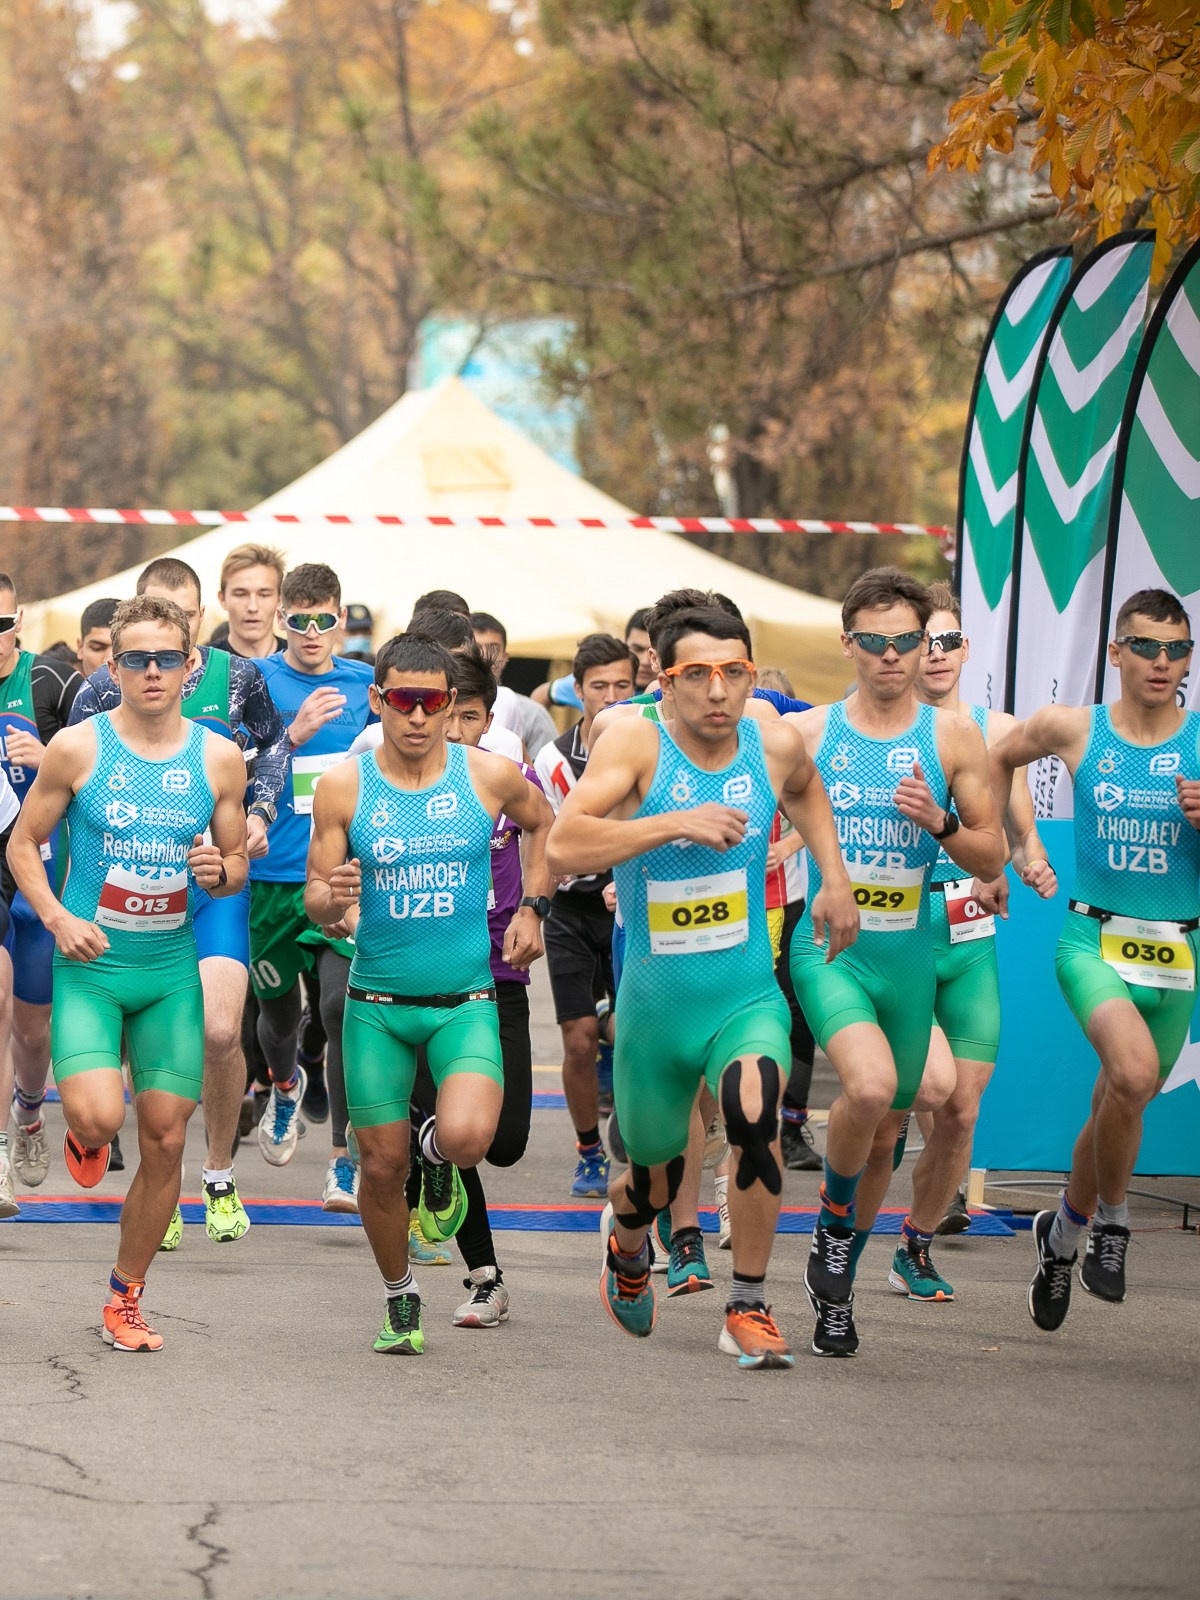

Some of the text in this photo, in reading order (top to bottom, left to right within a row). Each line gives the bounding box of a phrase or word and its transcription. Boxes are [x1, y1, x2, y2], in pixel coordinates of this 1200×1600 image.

[1128, 794, 1180, 804] TRIATHLO
[141, 812, 198, 825] TRIATHLON
[1096, 815, 1182, 847] KHODJAEV
[103, 831, 190, 863] Reshetnikov
[408, 839, 469, 850] TRIATHLON
[1108, 843, 1169, 874] UZB
[374, 860, 470, 891] KHAMROEV
[124, 896, 170, 913] 013
[389, 891, 455, 919] UZB
[852, 887, 905, 909] 029
[964, 900, 986, 918] 0
[671, 901, 730, 927] 028
[1121, 941, 1175, 964] 030
[250, 959, 282, 989] 10
